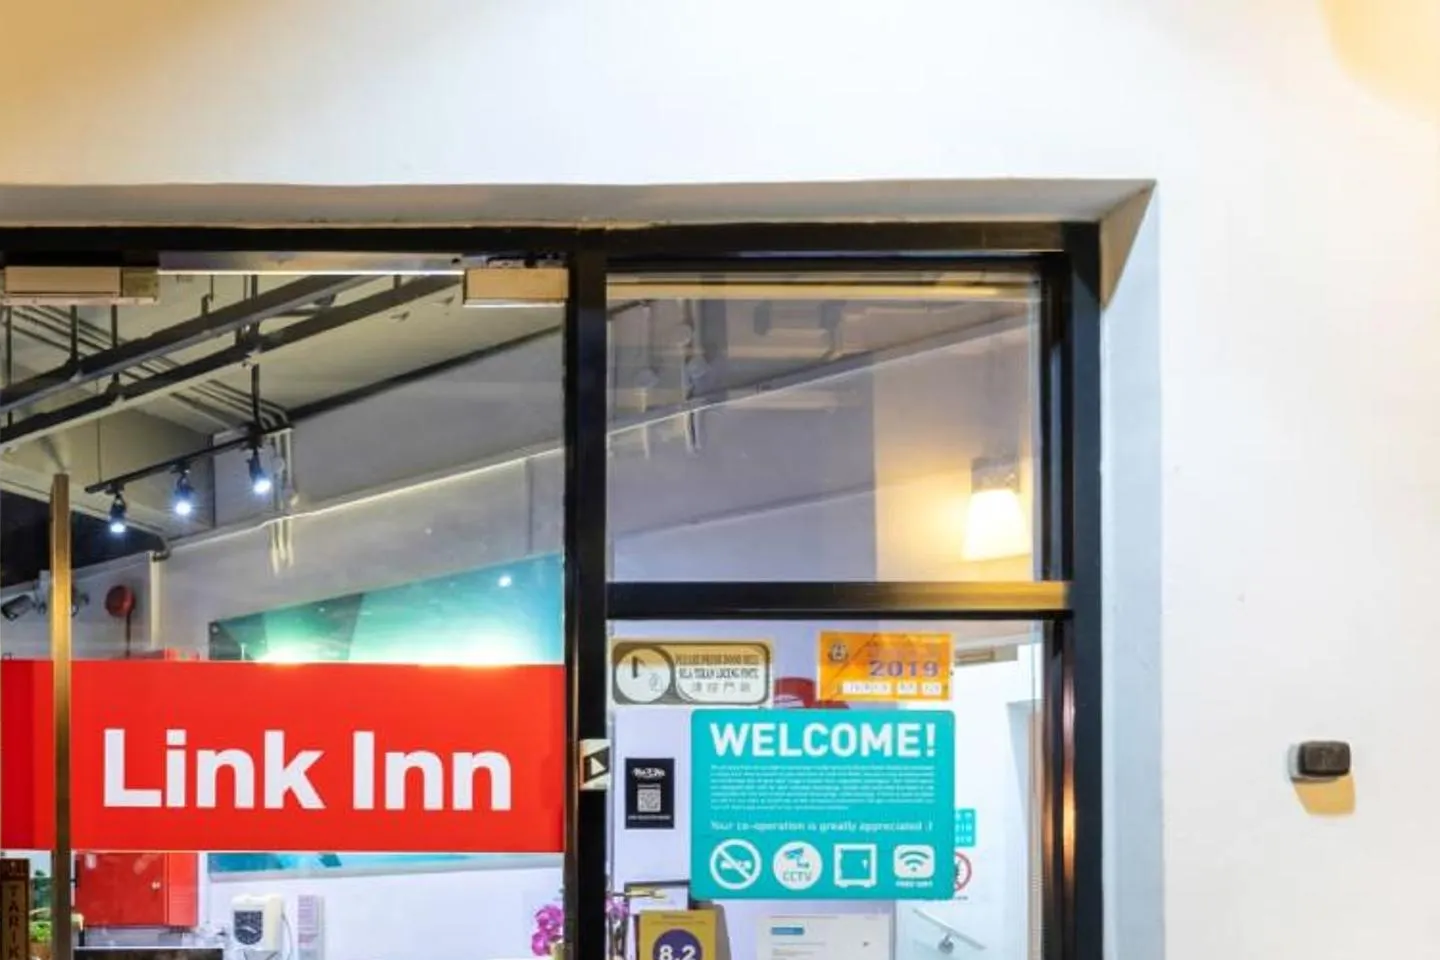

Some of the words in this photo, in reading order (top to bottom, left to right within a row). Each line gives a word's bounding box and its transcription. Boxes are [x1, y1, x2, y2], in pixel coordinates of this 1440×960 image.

[869, 660, 939, 677] 2019
[710, 723, 936, 757] WELCOME!
[103, 728, 325, 810] Link
[353, 731, 511, 811] Inn
